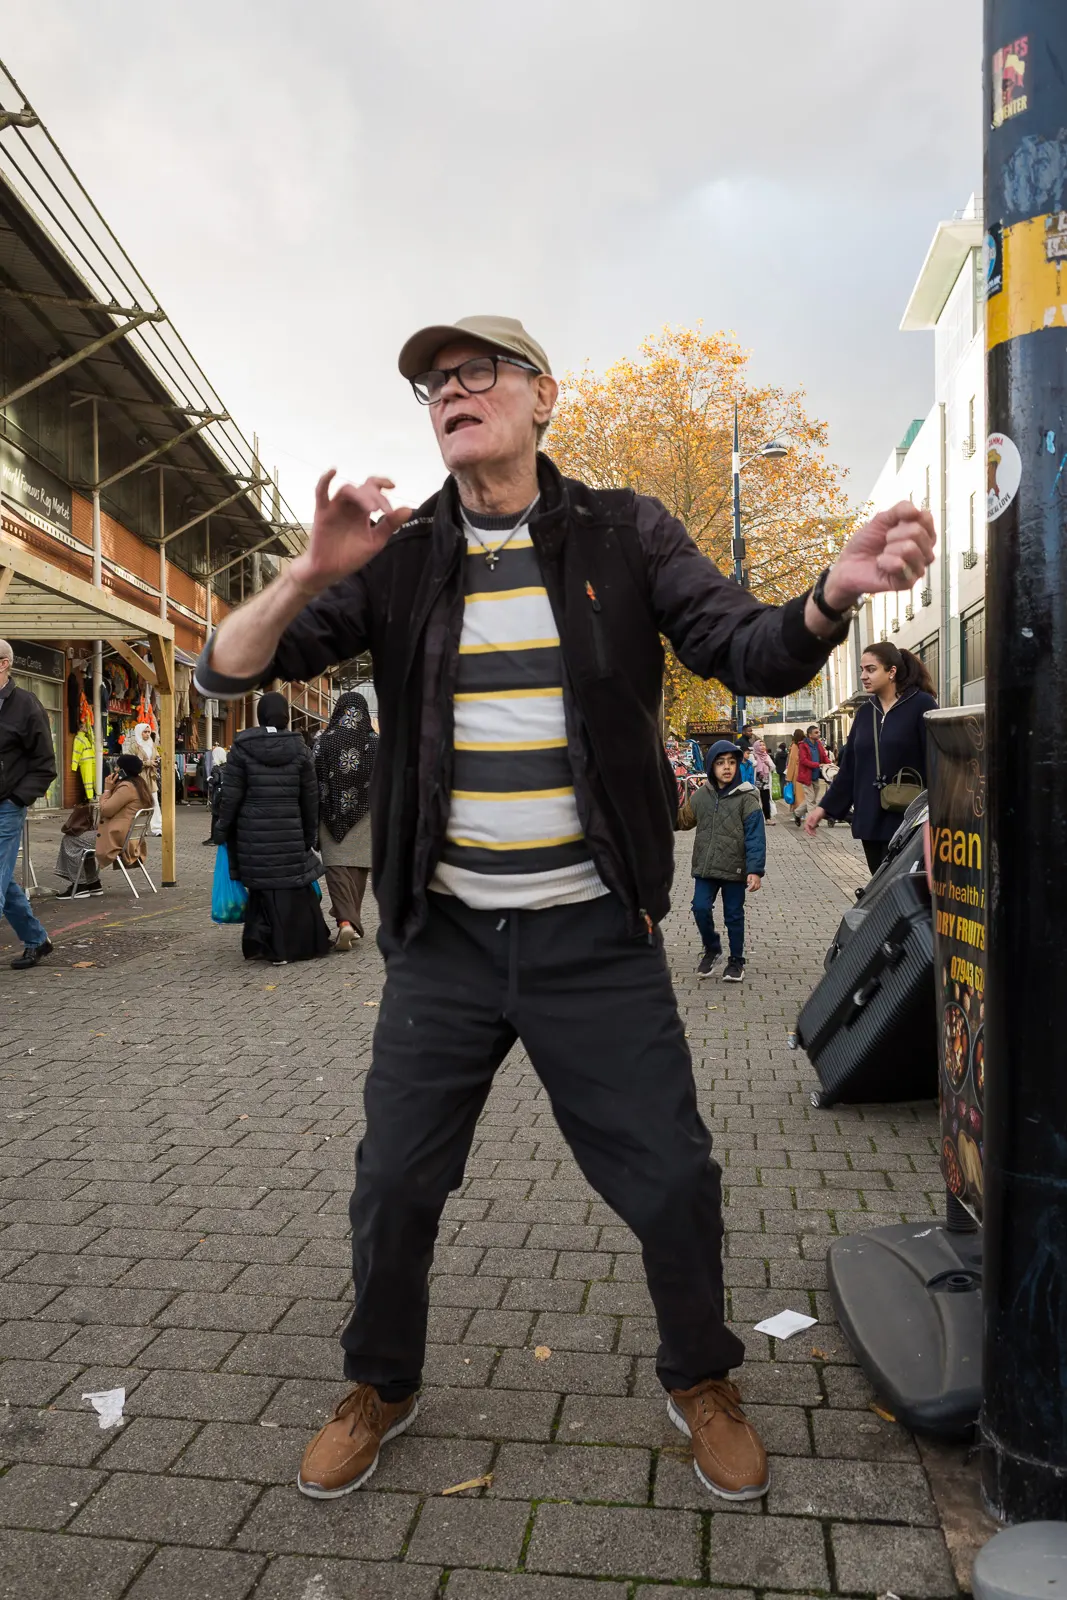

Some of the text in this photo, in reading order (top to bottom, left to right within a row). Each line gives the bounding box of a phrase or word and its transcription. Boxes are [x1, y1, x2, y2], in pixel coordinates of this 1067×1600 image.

[40, 487, 52, 517] Rag
[929, 825, 982, 870] yaan
[932, 880, 947, 898] our
[948, 879, 979, 907] health
[936, 909, 986, 952] DRY FRUITS
[950, 955, 986, 993] 07943 62
